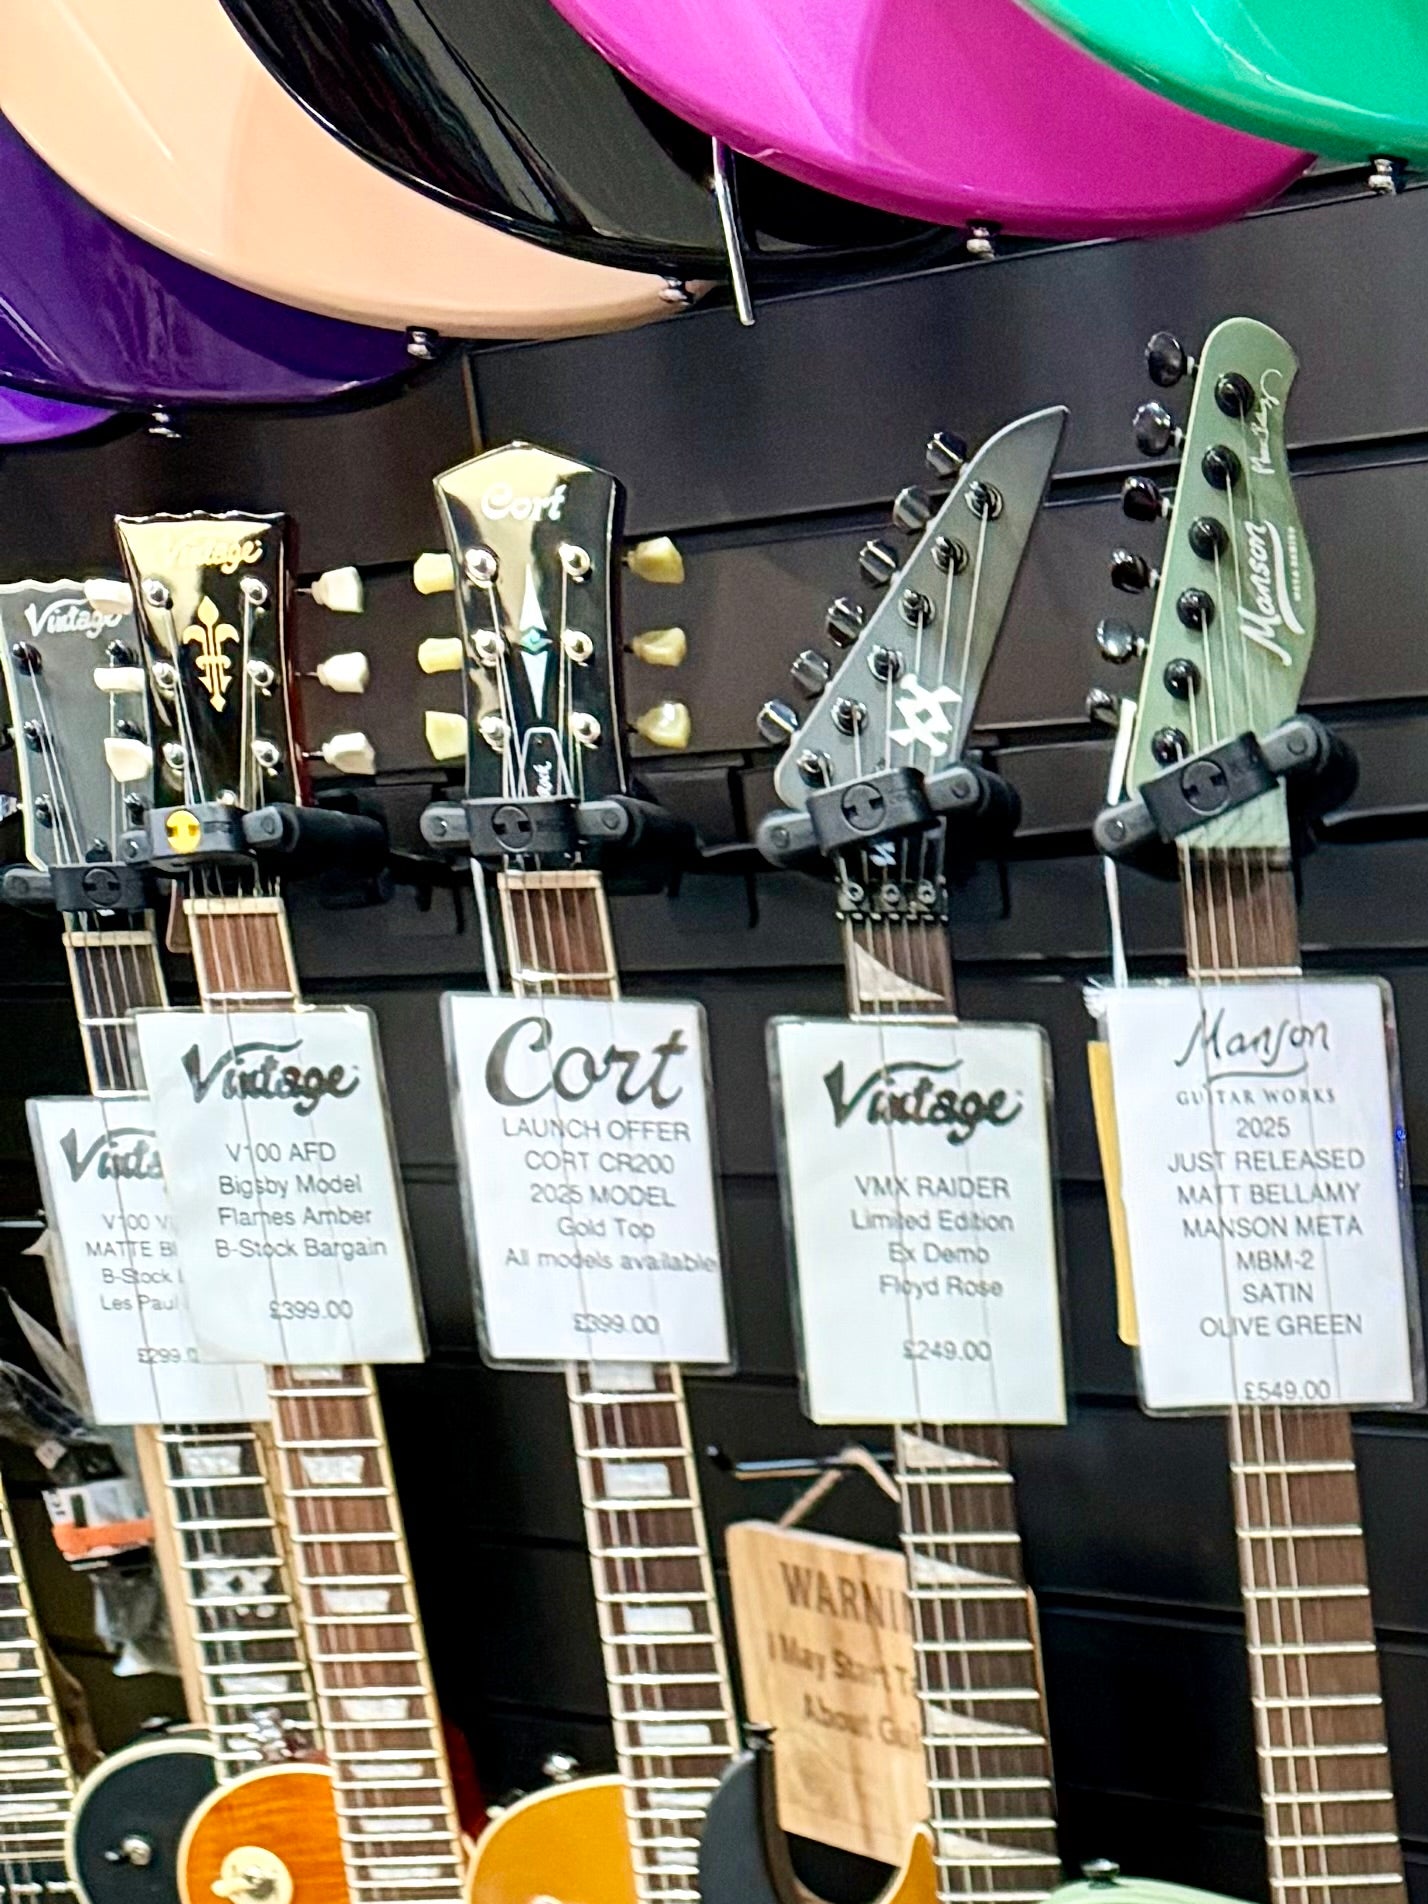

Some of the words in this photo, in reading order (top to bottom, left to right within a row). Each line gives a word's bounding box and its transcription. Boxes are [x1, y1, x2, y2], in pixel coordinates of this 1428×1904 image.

[481, 482, 567, 522] Cort
[1238, 520, 1305, 667] Manson
[1174, 1007, 1329, 1070] Manson
[485, 1016, 688, 1109] Cort
[181, 1038, 360, 1117] Vintage
[823, 1060, 1023, 1146] Vintage
[1176, 1088, 1255, 1106] GUITAR
[1264, 1087, 1336, 1105] WORKS
[502, 1119, 600, 1139] LAUNCH
[608, 1120, 690, 1143] OFFER
[1236, 1118, 1290, 1139] 2025
[226, 1143, 281, 1162] V100
[290, 1143, 336, 1162] AFD
[525, 1150, 590, 1172] CORT
[600, 1152, 674, 1174] CR200
[1168, 1150, 1224, 1172] JUST
[1235, 1149, 1365, 1172] RELEASED
[219, 1176, 288, 1198] Bigsby
[300, 1175, 362, 1194] Model
[530, 1184, 582, 1204] 2025
[590, 1186, 676, 1208] MODEL
[855, 1174, 910, 1198] VMX
[918, 1176, 1011, 1199] RAIDER
[1177, 1184, 1240, 1205] MATT
[1250, 1182, 1361, 1204] BELLAMY
[218, 1207, 295, 1226] Flames
[303, 1208, 372, 1226] Amber
[558, 1216, 605, 1238] Gold
[615, 1218, 655, 1240] Top
[851, 1209, 929, 1231] Limited
[939, 1210, 1014, 1233] Edition
[1183, 1217, 1288, 1239] MANSON
[1296, 1216, 1363, 1236] META
[86, 1242, 152, 1258] MATTE
[215, 1239, 298, 1258] B-Stock
[306, 1239, 387, 1262] Bargain
[506, 1248, 529, 1267] All
[538, 1250, 613, 1269] models
[620, 1252, 718, 1274] available
[889, 1242, 917, 1263] Ex
[924, 1243, 991, 1265] Demo
[1237, 1250, 1315, 1272] MBM-2
[103, 1267, 172, 1284] B-Stock
[880, 1274, 938, 1300] Floyd
[946, 1275, 1003, 1298] Rose
[101, 1295, 131, 1311] Les
[138, 1296, 178, 1311] Paul
[1242, 1282, 1313, 1303] SATIN
[269, 1300, 353, 1320] £399.00
[1200, 1316, 1268, 1338] OLIVE
[1277, 1313, 1363, 1335] GREEN
[902, 1340, 993, 1363] £249.00
[1244, 1380, 1331, 1401] £549.00
